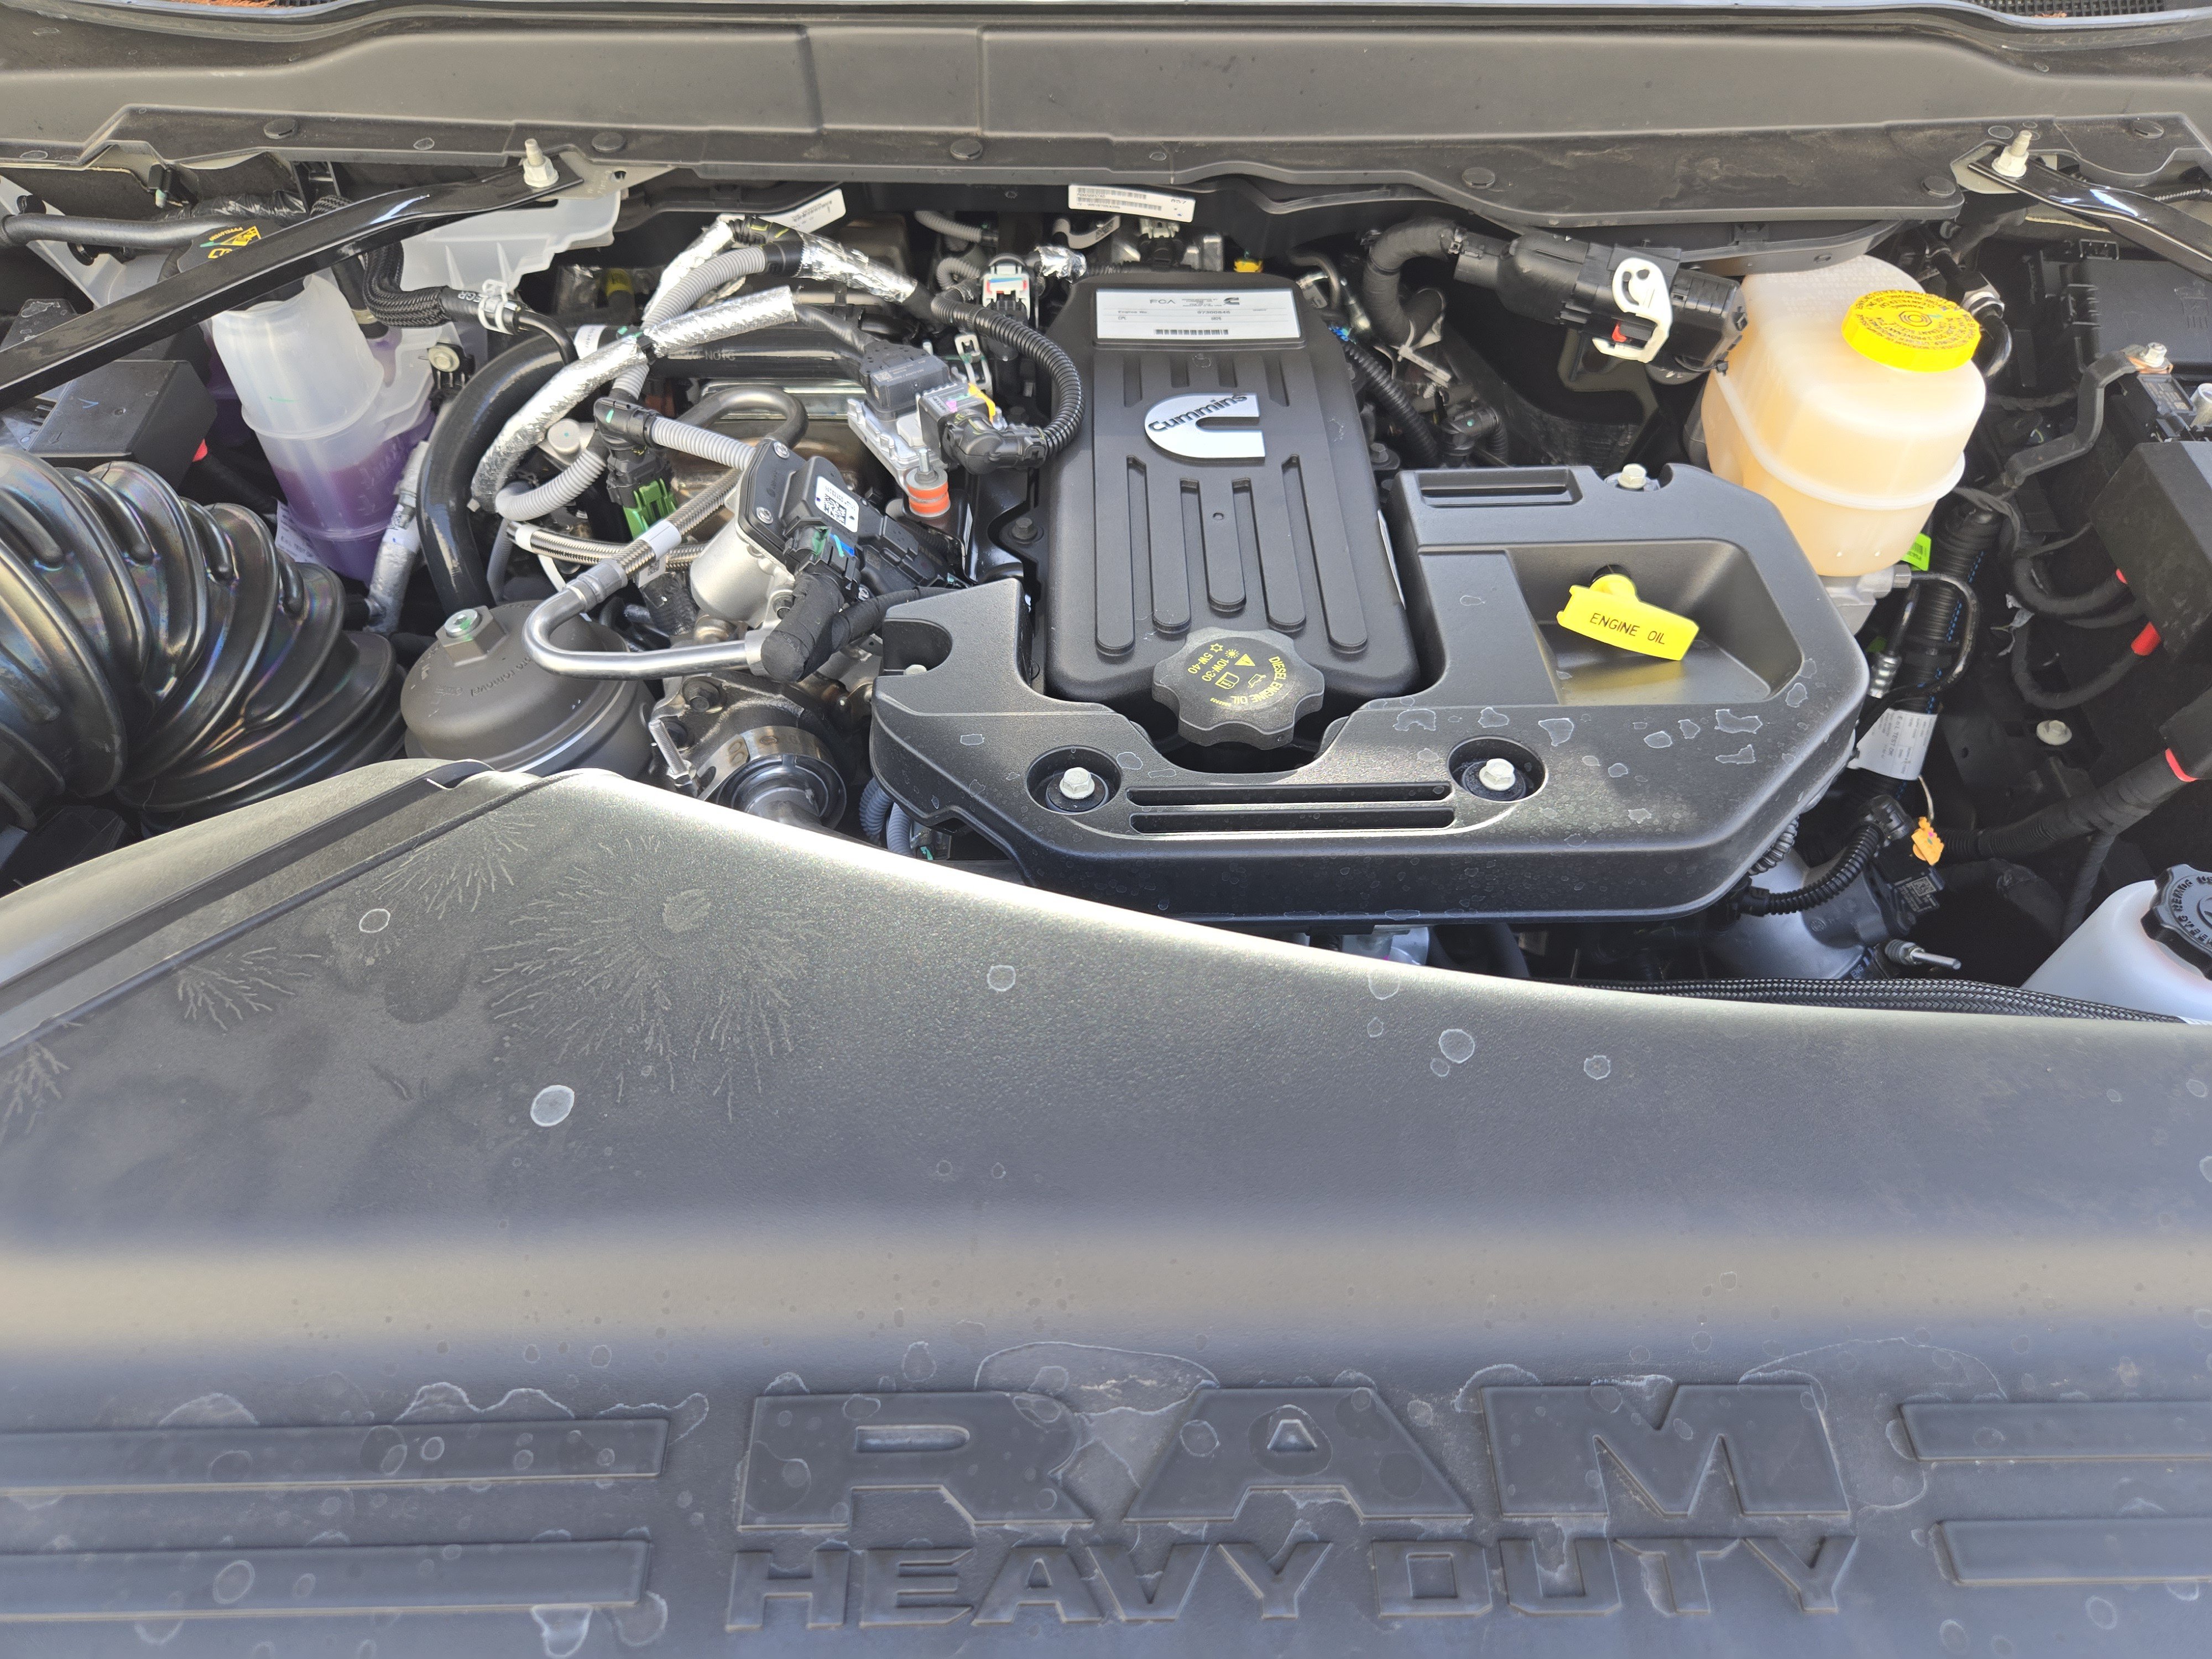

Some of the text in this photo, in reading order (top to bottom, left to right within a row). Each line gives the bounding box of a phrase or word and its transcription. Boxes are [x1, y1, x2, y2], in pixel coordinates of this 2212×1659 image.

[1148, 395, 1248, 432] Cummins
[1590, 613, 1665, 645] ENGINE OIL
[1187, 652, 1214, 675] 5W-40
[1202, 658, 1229, 682] 10W-30
[1269, 656, 1287, 681] DIESEL
[1230, 696, 1249, 705] OIL
[1251, 681, 1284, 703] ENGINE
[1891, 732, 1899, 746] TEST
[737, 1384, 1851, 1530] RAM
[727, 1536, 1859, 1630] HEAVY DUTY
